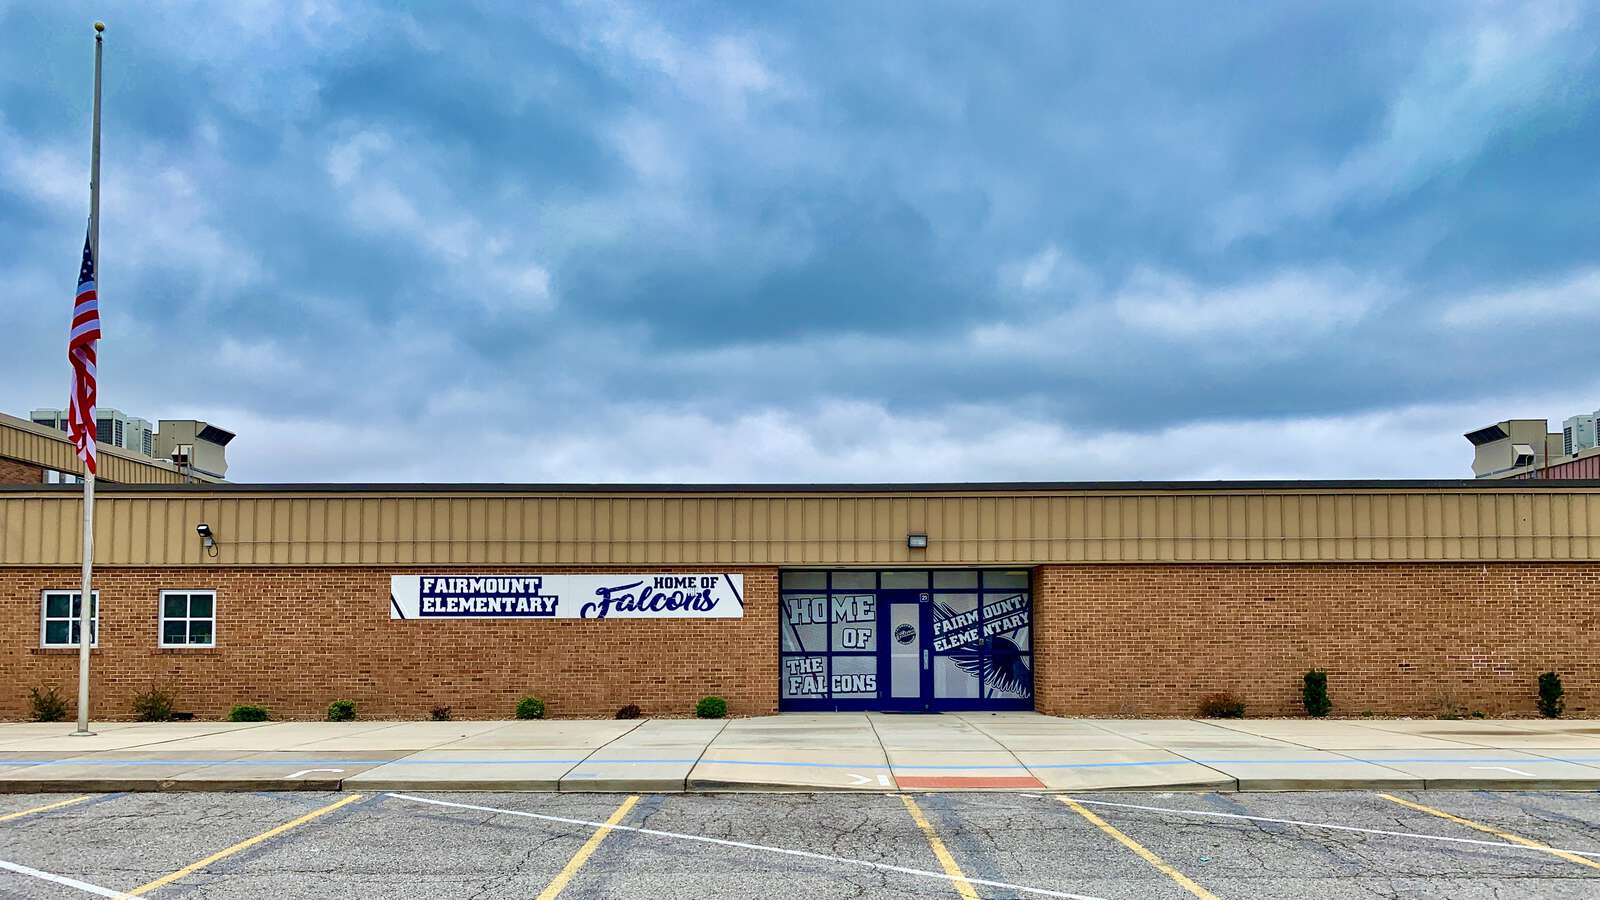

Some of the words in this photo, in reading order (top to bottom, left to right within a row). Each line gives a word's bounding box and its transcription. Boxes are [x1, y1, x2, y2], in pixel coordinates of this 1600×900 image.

[422, 578, 539, 593] FAIRMOUNT
[653, 576, 697, 589] HOME
[700, 576, 719, 589] OF
[422, 597, 556, 612] ELEMENTARY
[580, 580, 720, 619] Falcons
[788, 595, 876, 625] HOME
[933, 596, 1022, 635] FAIRMOUNT
[842, 627, 872, 649] OF
[933, 612, 1028, 652] ELEMENTARY
[786, 658, 823, 675] THE
[788, 674, 877, 695] FALCONS
